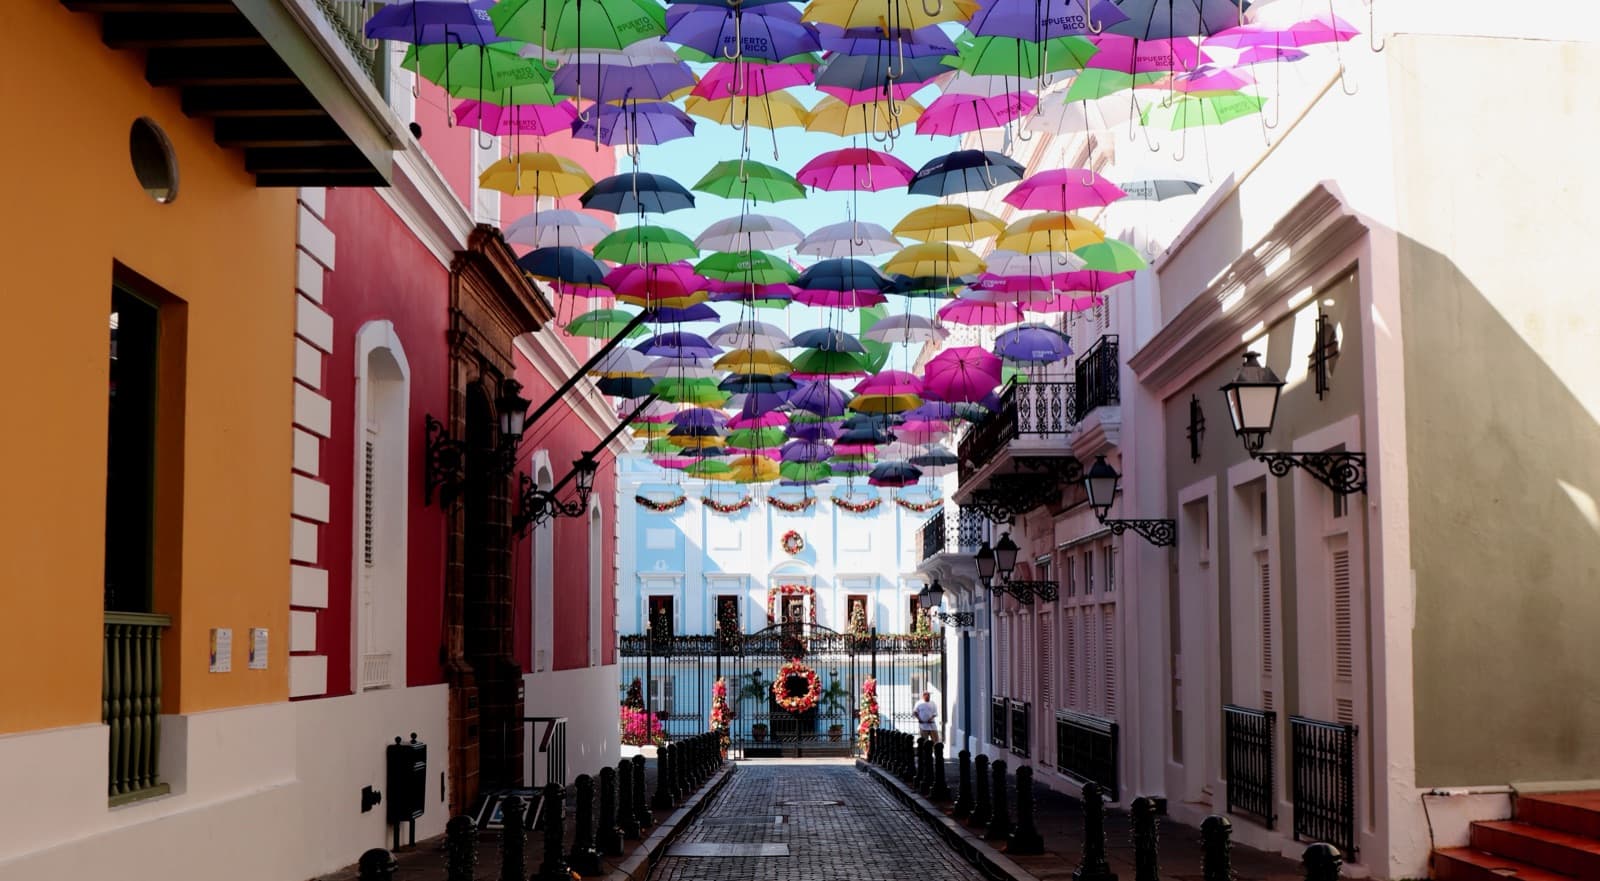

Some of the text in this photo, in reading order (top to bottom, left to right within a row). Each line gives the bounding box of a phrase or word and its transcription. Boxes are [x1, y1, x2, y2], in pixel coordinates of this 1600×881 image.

[1041, 15, 1083, 26] #PUERTO
[1063, 23, 1086, 31] RICO
[724, 36, 767, 45] #PERTO
[745, 44, 767, 52] RICO
